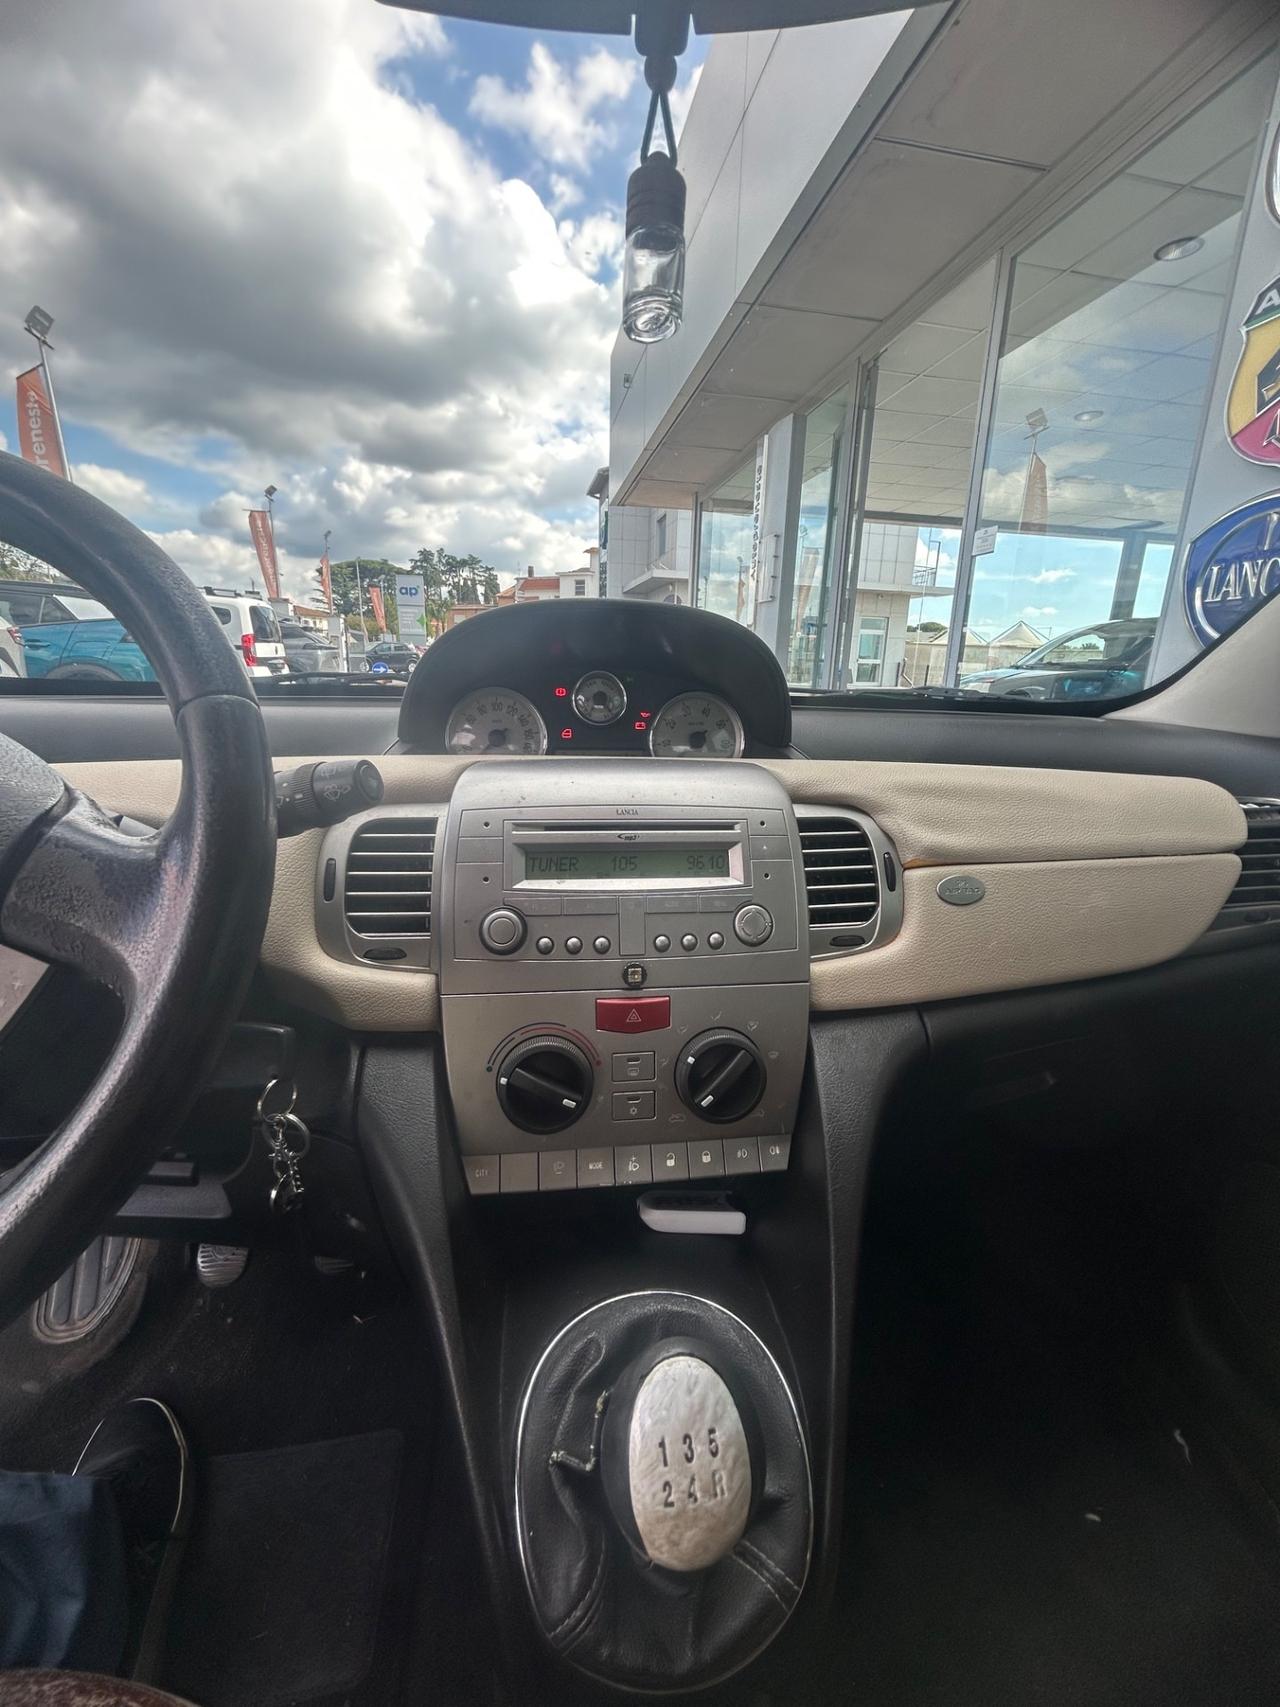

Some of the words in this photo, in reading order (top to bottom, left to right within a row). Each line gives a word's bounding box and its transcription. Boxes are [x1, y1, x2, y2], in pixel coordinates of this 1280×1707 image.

[399, 586, 418, 597] ap
[616, 807, 639, 816] LANCIA
[529, 856, 580, 873] TUNER
[611, 855, 639, 872] 105
[588, 1161, 604, 1170] MODE
[474, 1168, 489, 1179] CITY
[658, 1435, 669, 1468] 1
[682, 1432, 695, 1464] 3
[707, 1427, 720, 1459] 5
[662, 1480, 675, 1508] 2
